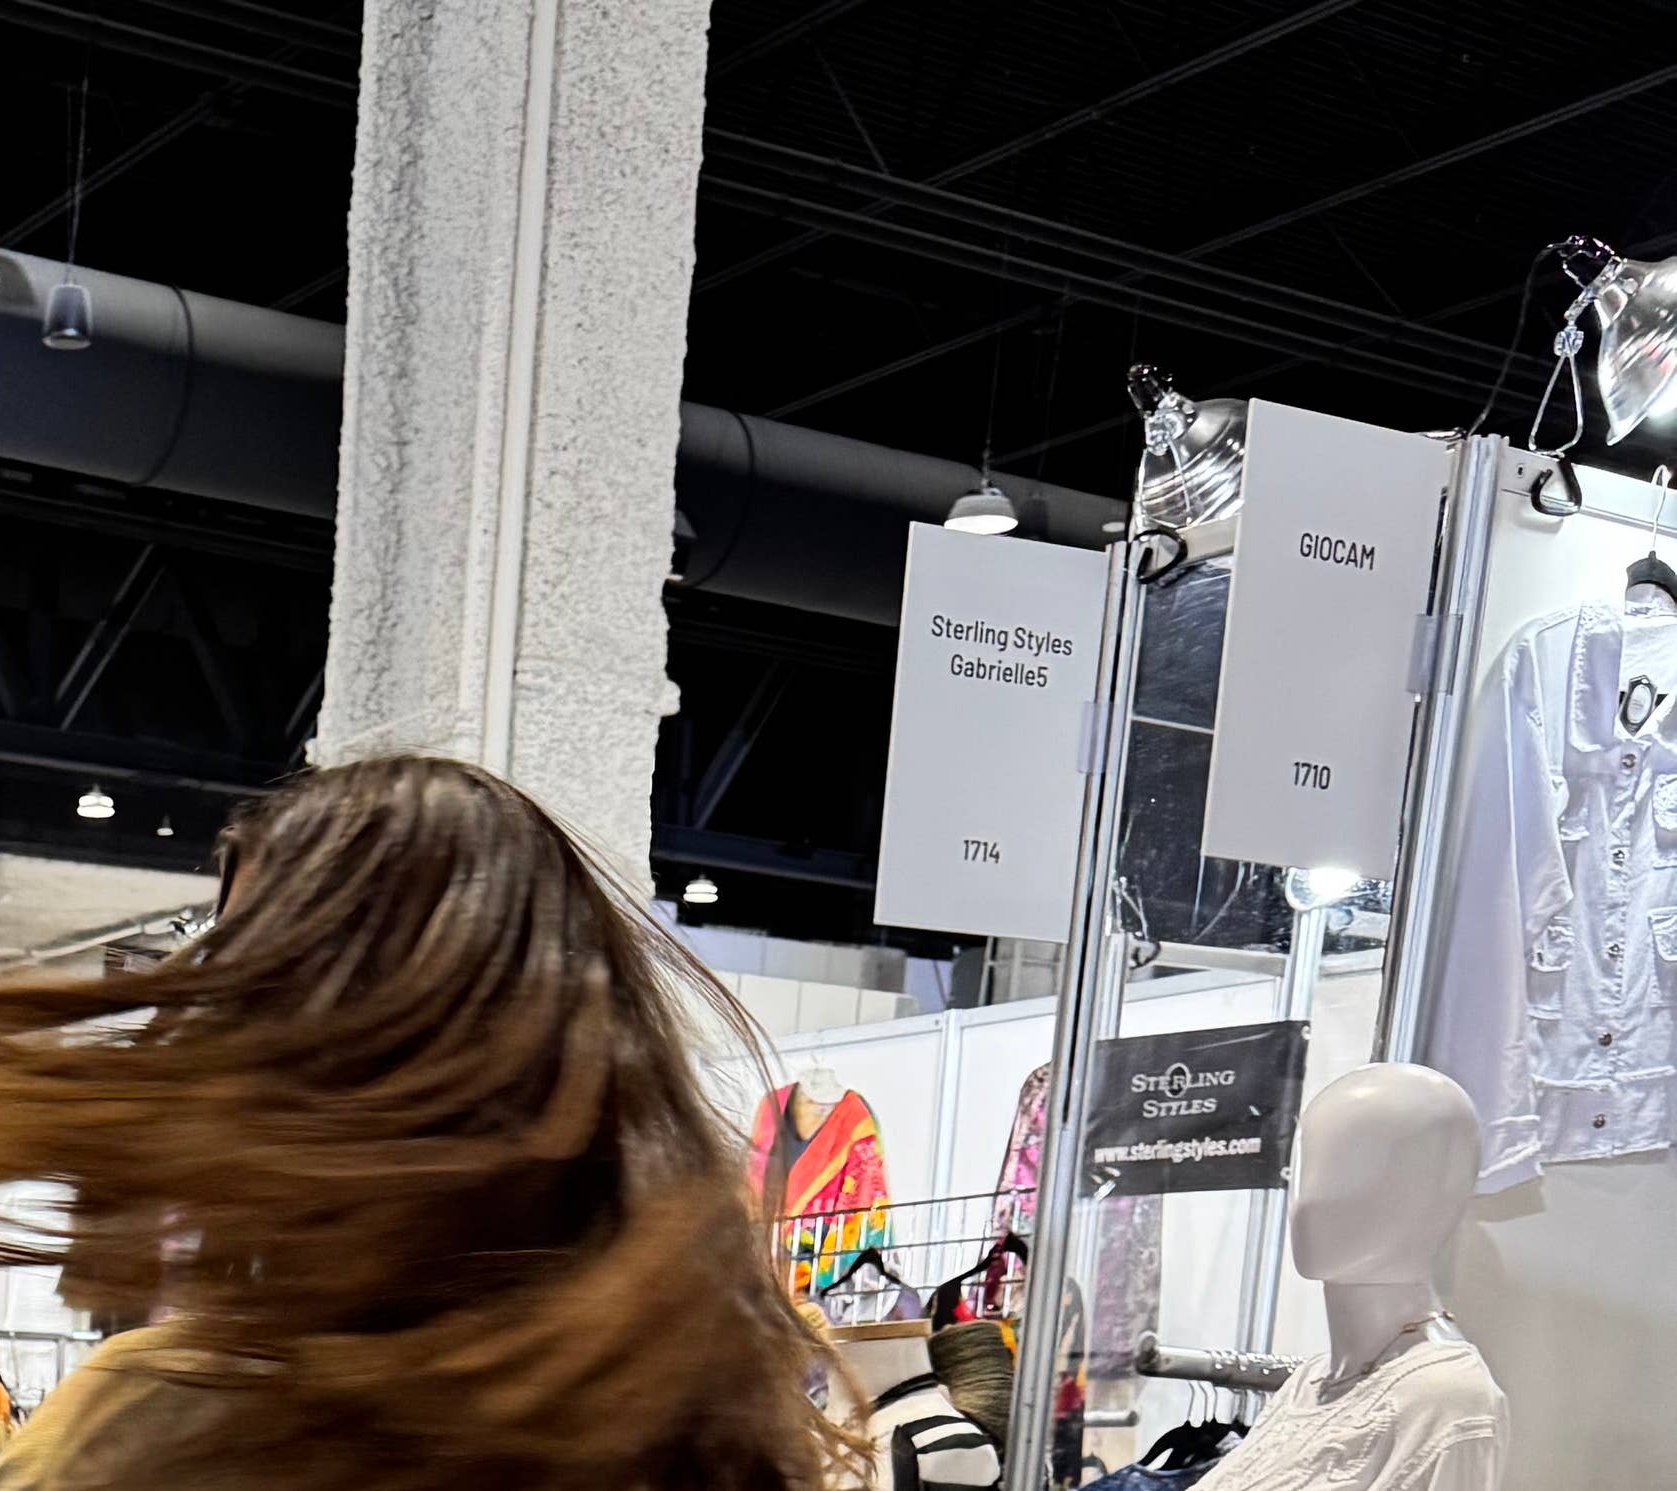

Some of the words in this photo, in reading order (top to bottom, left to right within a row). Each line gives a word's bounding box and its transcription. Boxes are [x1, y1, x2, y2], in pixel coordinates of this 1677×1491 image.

[1299, 533, 1375, 571] GIOCAM
[931, 615, 1009, 652] Sterling
[1013, 627, 1073, 657] Styles
[950, 653, 1050, 688] Gabrielle5
[1293, 761, 1331, 790] 1710
[962, 839, 1001, 865] 1714
[1130, 1067, 1236, 1095] STERLING
[1141, 1097, 1219, 1119] STYLES
[1093, 1136, 1262, 1164] www.sterlingstyles.com
